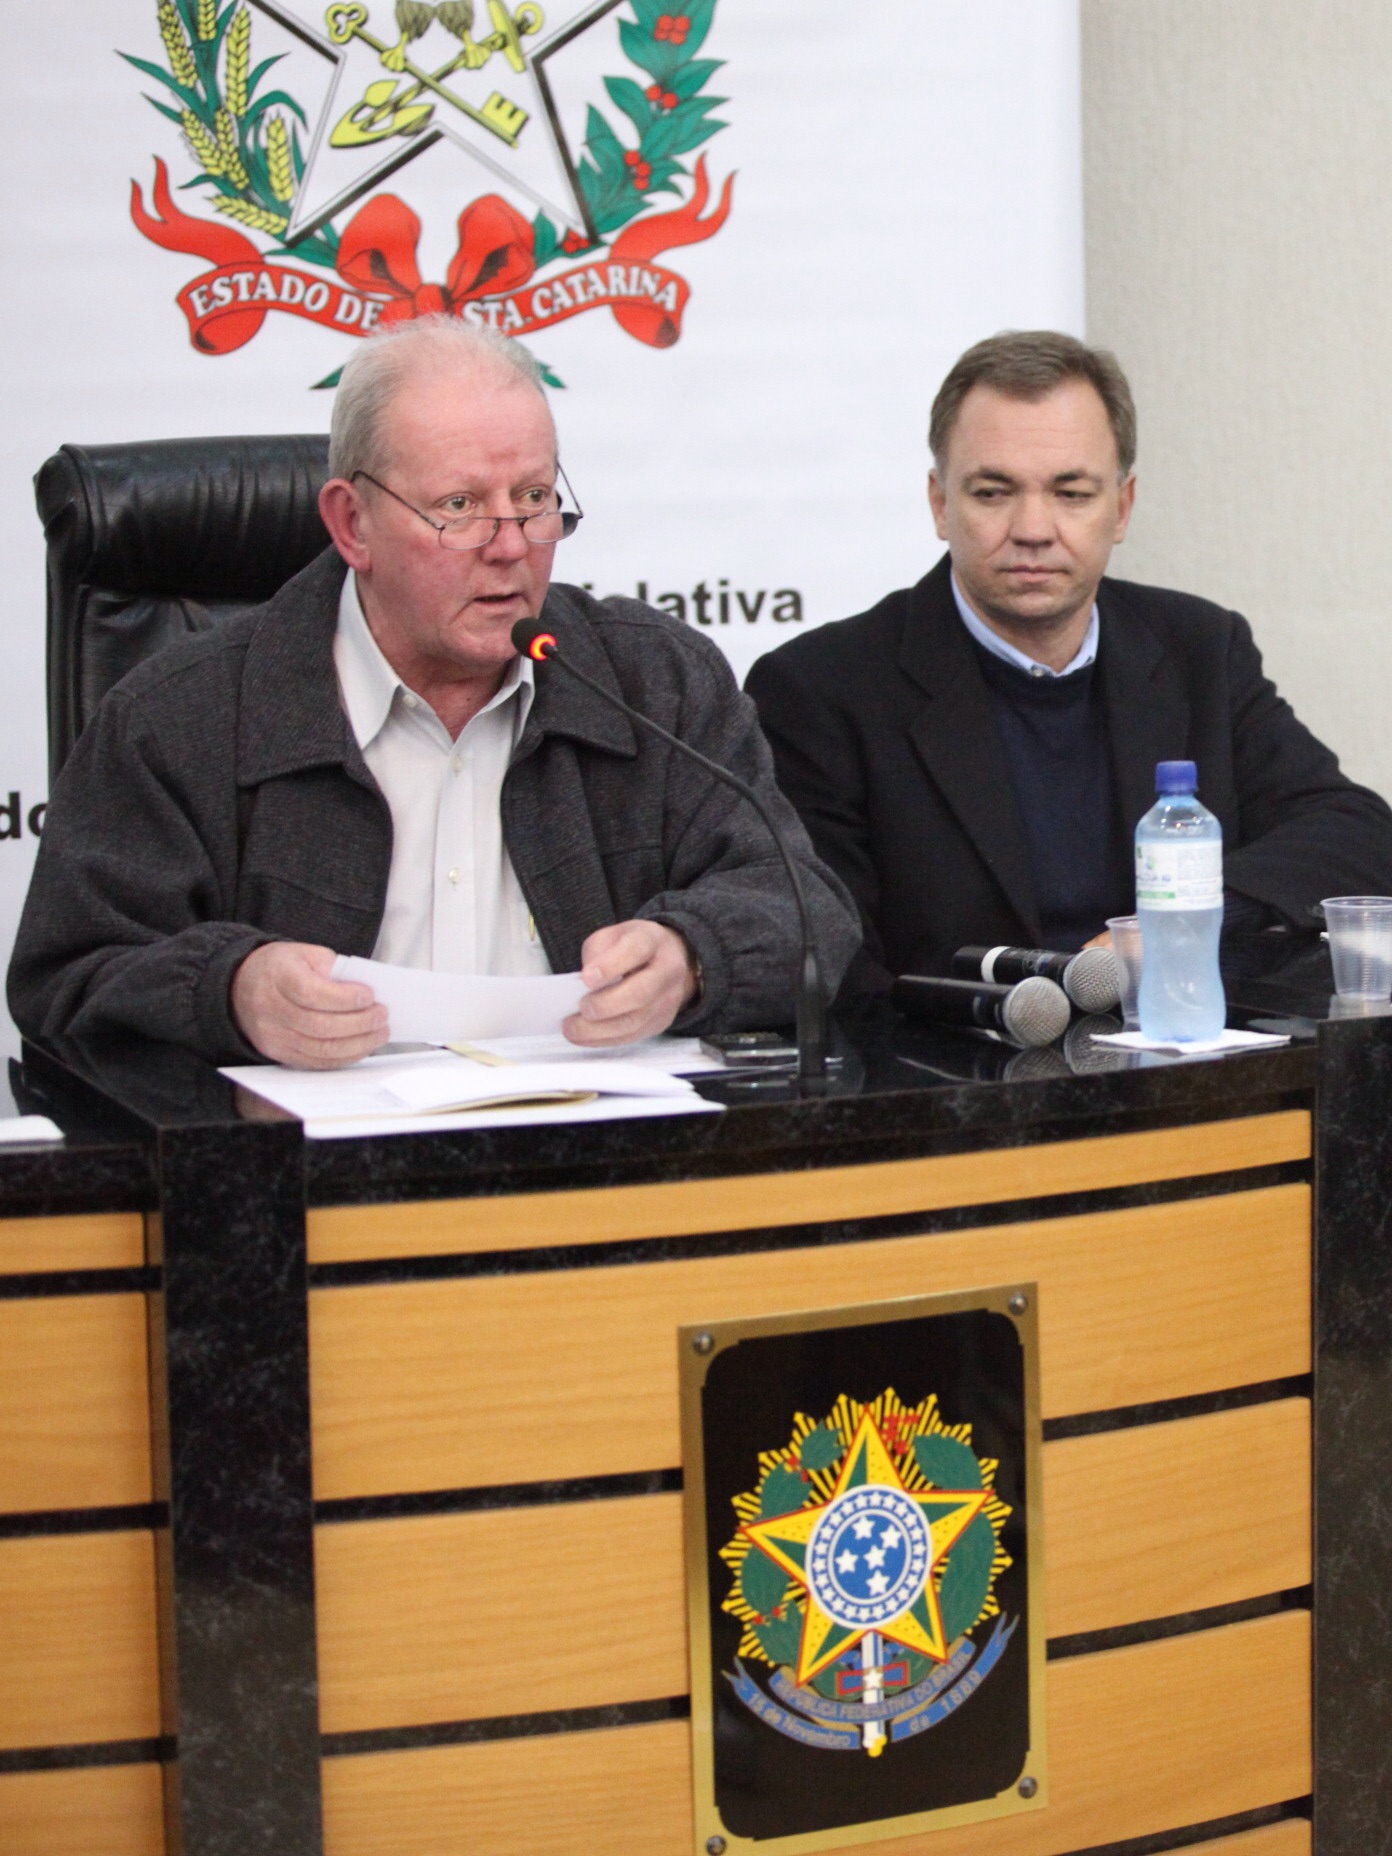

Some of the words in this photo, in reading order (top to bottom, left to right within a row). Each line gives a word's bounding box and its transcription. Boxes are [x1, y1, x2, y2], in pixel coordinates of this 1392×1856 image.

[188, 270, 330, 318] ESTADO
[333, 292, 384, 331] DE
[531, 264, 678, 312] CATARINA
